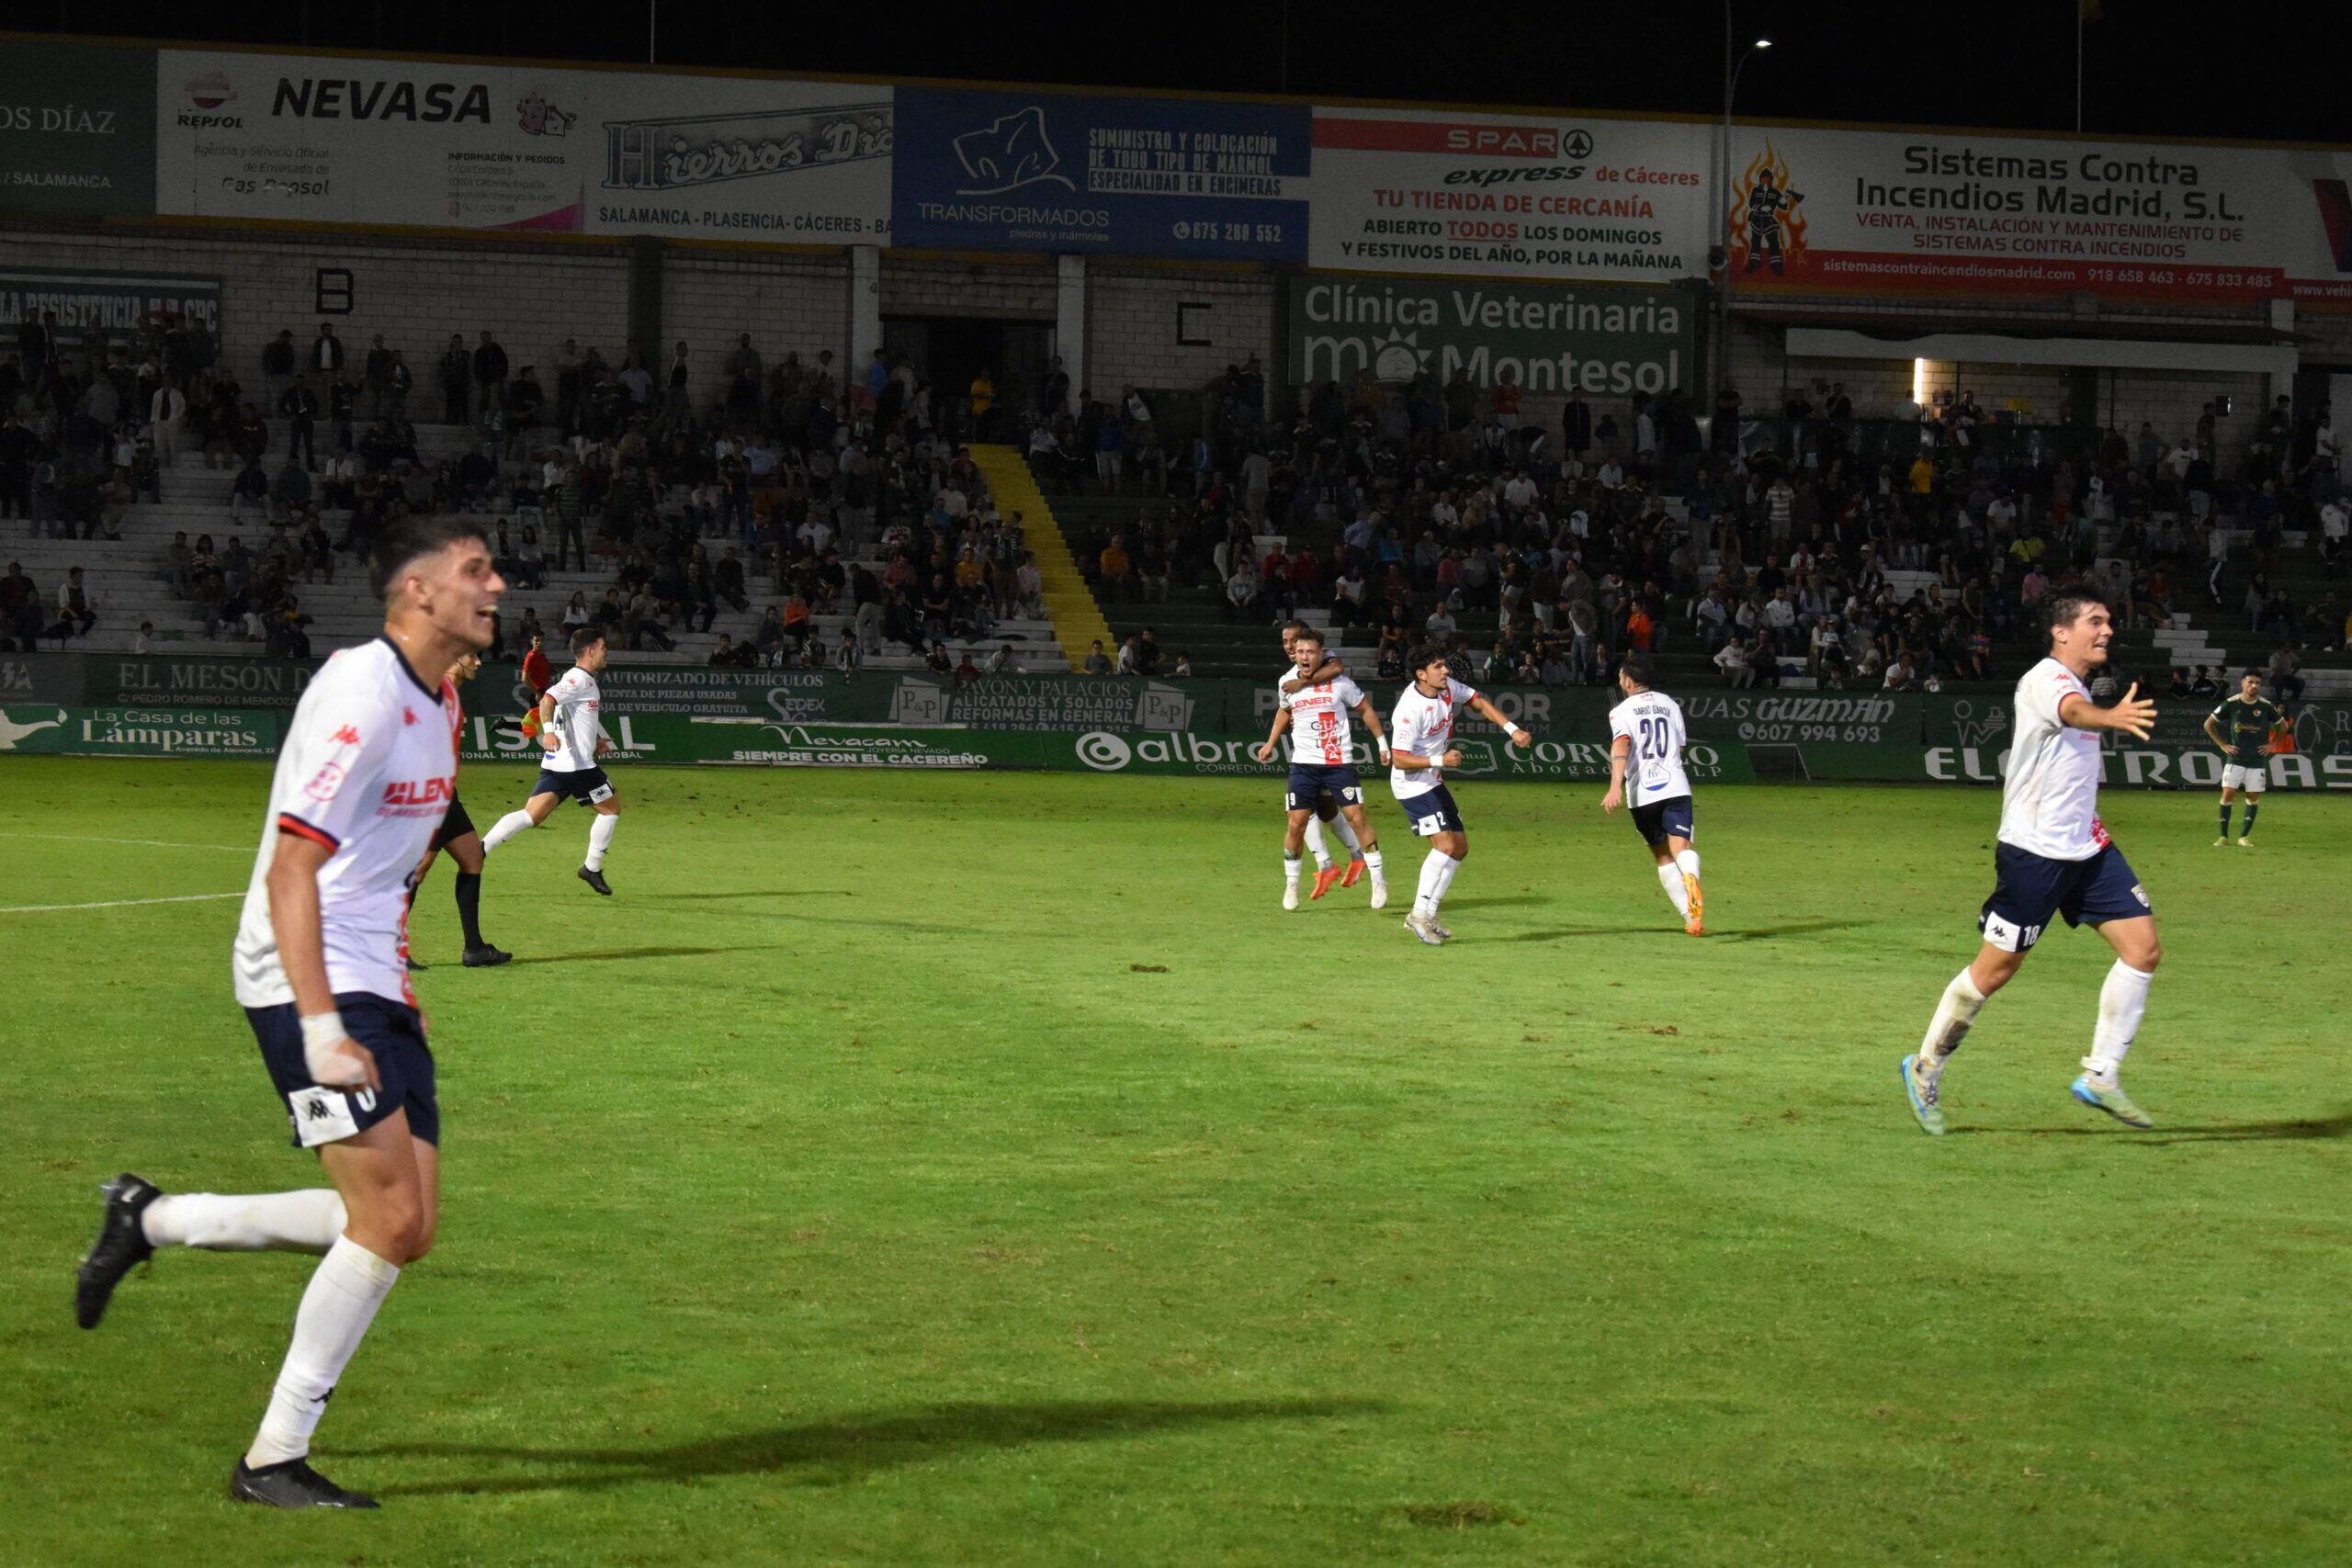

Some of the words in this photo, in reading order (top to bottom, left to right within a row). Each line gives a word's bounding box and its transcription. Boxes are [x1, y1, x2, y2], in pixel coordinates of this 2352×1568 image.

[272, 77, 491, 124] NEVASA
[40, 105, 115, 134] DÍAZ
[177, 115, 243, 129] REPSOL
[194, 145, 237, 157] Agencia
[241, 148, 246, 158] y
[250, 145, 292, 158] Servicio
[295, 148, 329, 158] Oficial
[1088, 129, 1172, 151] SUMINISTRO
[1179, 132, 1189, 151] Y
[1194, 130, 1278, 155] COLOCACIÓN
[1447, 129, 1557, 152] SPAR
[448, 152, 513, 163] INFORMACIÓN
[526, 155, 566, 164] PEDIDOS
[602, 121, 804, 190] Hierros
[1089, 148, 1106, 166] DE
[1113, 150, 1148, 169] TODO
[1155, 152, 1186, 171] TIPO
[1193, 153, 1210, 172] DE
[1216, 152, 1274, 175] MÁRMOL
[1904, 145, 2069, 180] Sistemas
[2080, 154, 2199, 186] Contra
[12, 172, 111, 189] SALAMANCA
[243, 162, 257, 173] de
[259, 162, 312, 175] Envasado
[315, 164, 330, 175] de
[1443, 164, 1587, 187] express
[1596, 167, 1618, 183] de
[1624, 165, 1701, 186] Cáceres
[1090, 171, 1181, 191] ESPECIALIDAD
[1187, 175, 1203, 193] EN
[1210, 175, 1281, 196] ENCIMERAS
[1374, 189, 1404, 208] TU
[1411, 191, 1496, 213] TIENDA
[1503, 195, 1533, 213] DE
[1539, 193, 1654, 219] CERCANÍA
[1856, 177, 2023, 213] Incendios
[2037, 186, 2171, 223] Madrid,
[2183, 192, 2245, 222] S.L.
[599, 208, 691, 226] SALAMANCA
[794, 212, 862, 232] CÁCERES
[918, 202, 1110, 228] TRANSFORMADOS
[1856, 212, 1920, 231] VENTA,
[1926, 214, 2042, 234] INSTALACIÓN
[2050, 221, 2060, 234] Y
[2065, 221, 2214, 242] MANTENIMIENTO
[2219, 228, 2244, 242] DE
[1010, 228, 1049, 241] piedras
[1050, 232, 1057, 242] y
[1058, 231, 1110, 242] mármoles
[1257, 225, 1282, 243] 552
[1363, 219, 1442, 237] ABIERTO
[1448, 220, 1520, 239] TODOS
[1525, 224, 1558, 241] LOS
[1563, 226, 1662, 245] DOMINGOS
[1341, 241, 1352, 255] Y
[1357, 243, 1443, 260] FESTIVOS
[1449, 245, 1482, 262] DEL
[1487, 243, 1532, 265] AÑO,
[1536, 249, 1572, 265] POR
[1577, 250, 1600, 266] LA
[1603, 248, 1682, 270] MAÑANA
[1913, 234, 2007, 252] SISTEMAS
[2012, 238, 2084, 254] CONTRA
[2091, 240, 2186, 258] INCENDIOS
[1823, 259, 2076, 282] sistemascontraincendiosmadrid.com
[2087, 270, 2115, 283] 918
[2119, 270, 2144, 284] 658
[2148, 271, 2175, 285] 463
[2187, 273, 2212, 287] 675
[2217, 273, 2245, 288] 833
[2247, 275, 2272, 288] 485
[315, 268, 354, 315] B
[1305, 284, 1439, 325] Clínica
[1453, 289, 1679, 333] Veterinaria
[1442, 344, 1679, 396] Montesol
[118, 662, 161, 689] EL
[169, 660, 284, 693] MESÓN
[602, 671, 707, 686] AUTORIZADO
[709, 673, 730, 686] DE
[733, 671, 823, 687] VEHÍCULOS
[131, 694, 171, 705] PEDRO
[173, 694, 221, 705] ROMERO
[224, 696, 240, 705] DE
[601, 689, 639, 699] VENTA
[640, 690, 653, 699] DE
[657, 690, 694, 700] PIEZAS
[697, 691, 737, 701] USADAS
[1018, 681, 1033, 695] Y
[1040, 681, 1132, 697] PALACIOS
[623, 703, 635, 713] DE
[637, 701, 690, 714] VEHÍCULO
[693, 704, 748, 715] GRATUITA
[955, 695, 1046, 708] ALICATADOS
[1052, 697, 1061, 708] Y
[1065, 697, 1134, 710] SOLADOS
[94, 709, 118, 723] La
[124, 711, 173, 724] Casa
[180, 711, 207, 725] de
[213, 712, 242, 726] las
[952, 707, 1035, 721] REFORMAS
[1038, 709, 1057, 721] EN
[1065, 709, 1134, 724] GENERAL
[82, 718, 258, 752] Lámparas
[759, 726, 927, 748] Nevacam
[1640, 717, 1668, 760] 20
[1756, 725, 1791, 741] 607
[1800, 725, 1837, 742] 994
[1843, 726, 1881, 743] 693
[175, 745, 209, 754] Avenida
[210, 746, 221, 754] de
[733, 751, 813, 762] SIEMPRE
[817, 752, 858, 763] CON
[862, 754, 880, 763] EL
[881, 751, 989, 765] CACEREÑO
